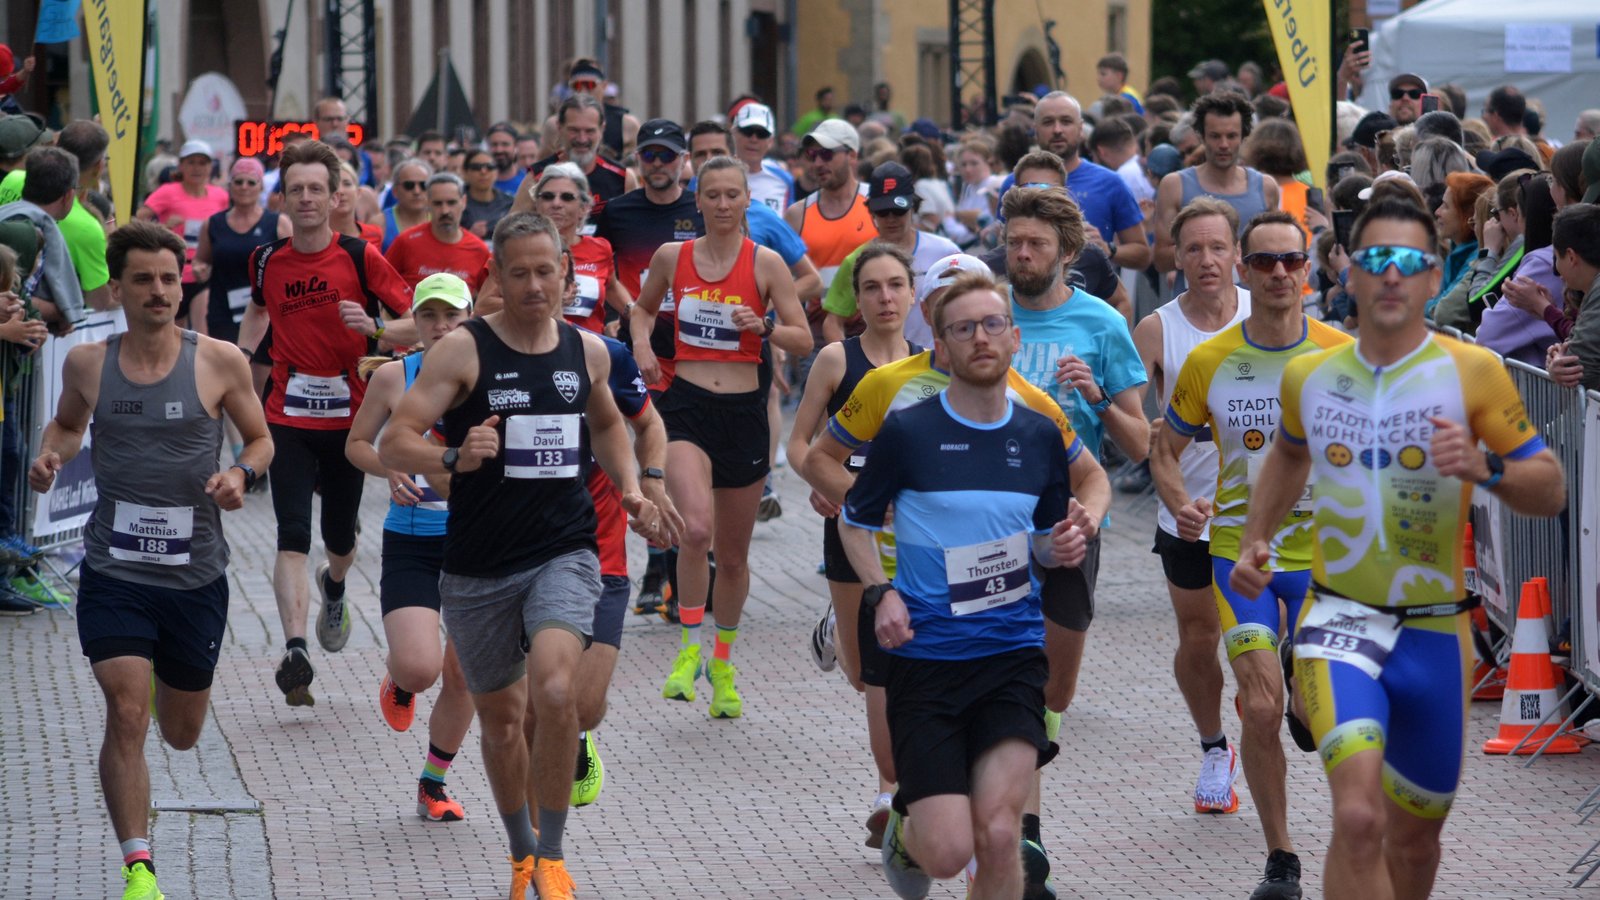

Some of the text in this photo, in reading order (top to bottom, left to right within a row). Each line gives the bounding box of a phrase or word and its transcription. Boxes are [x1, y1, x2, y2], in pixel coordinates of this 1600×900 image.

[280, 293, 338, 313] Bestickung
[694, 313, 724, 326] Hanna
[700, 326, 717, 340] 14
[302, 388, 336, 397] Markus
[112, 401, 142, 414] RRC
[306, 399, 329, 409] 111
[1228, 414, 1276, 428] MÜHL
[533, 436, 565, 446] David
[940, 442, 971, 451] BIORACER
[534, 451, 564, 466] 133
[129, 523, 177, 537] Matthias
[138, 538, 168, 553] 188
[966, 558, 1018, 578] Thorsten
[985, 577, 1006, 594] 43
[1327, 617, 1368, 635] André
[1322, 633, 1359, 651] 153
[1520, 693, 1540, 702] SWIM
[1520, 702, 1540, 711] BIKE
